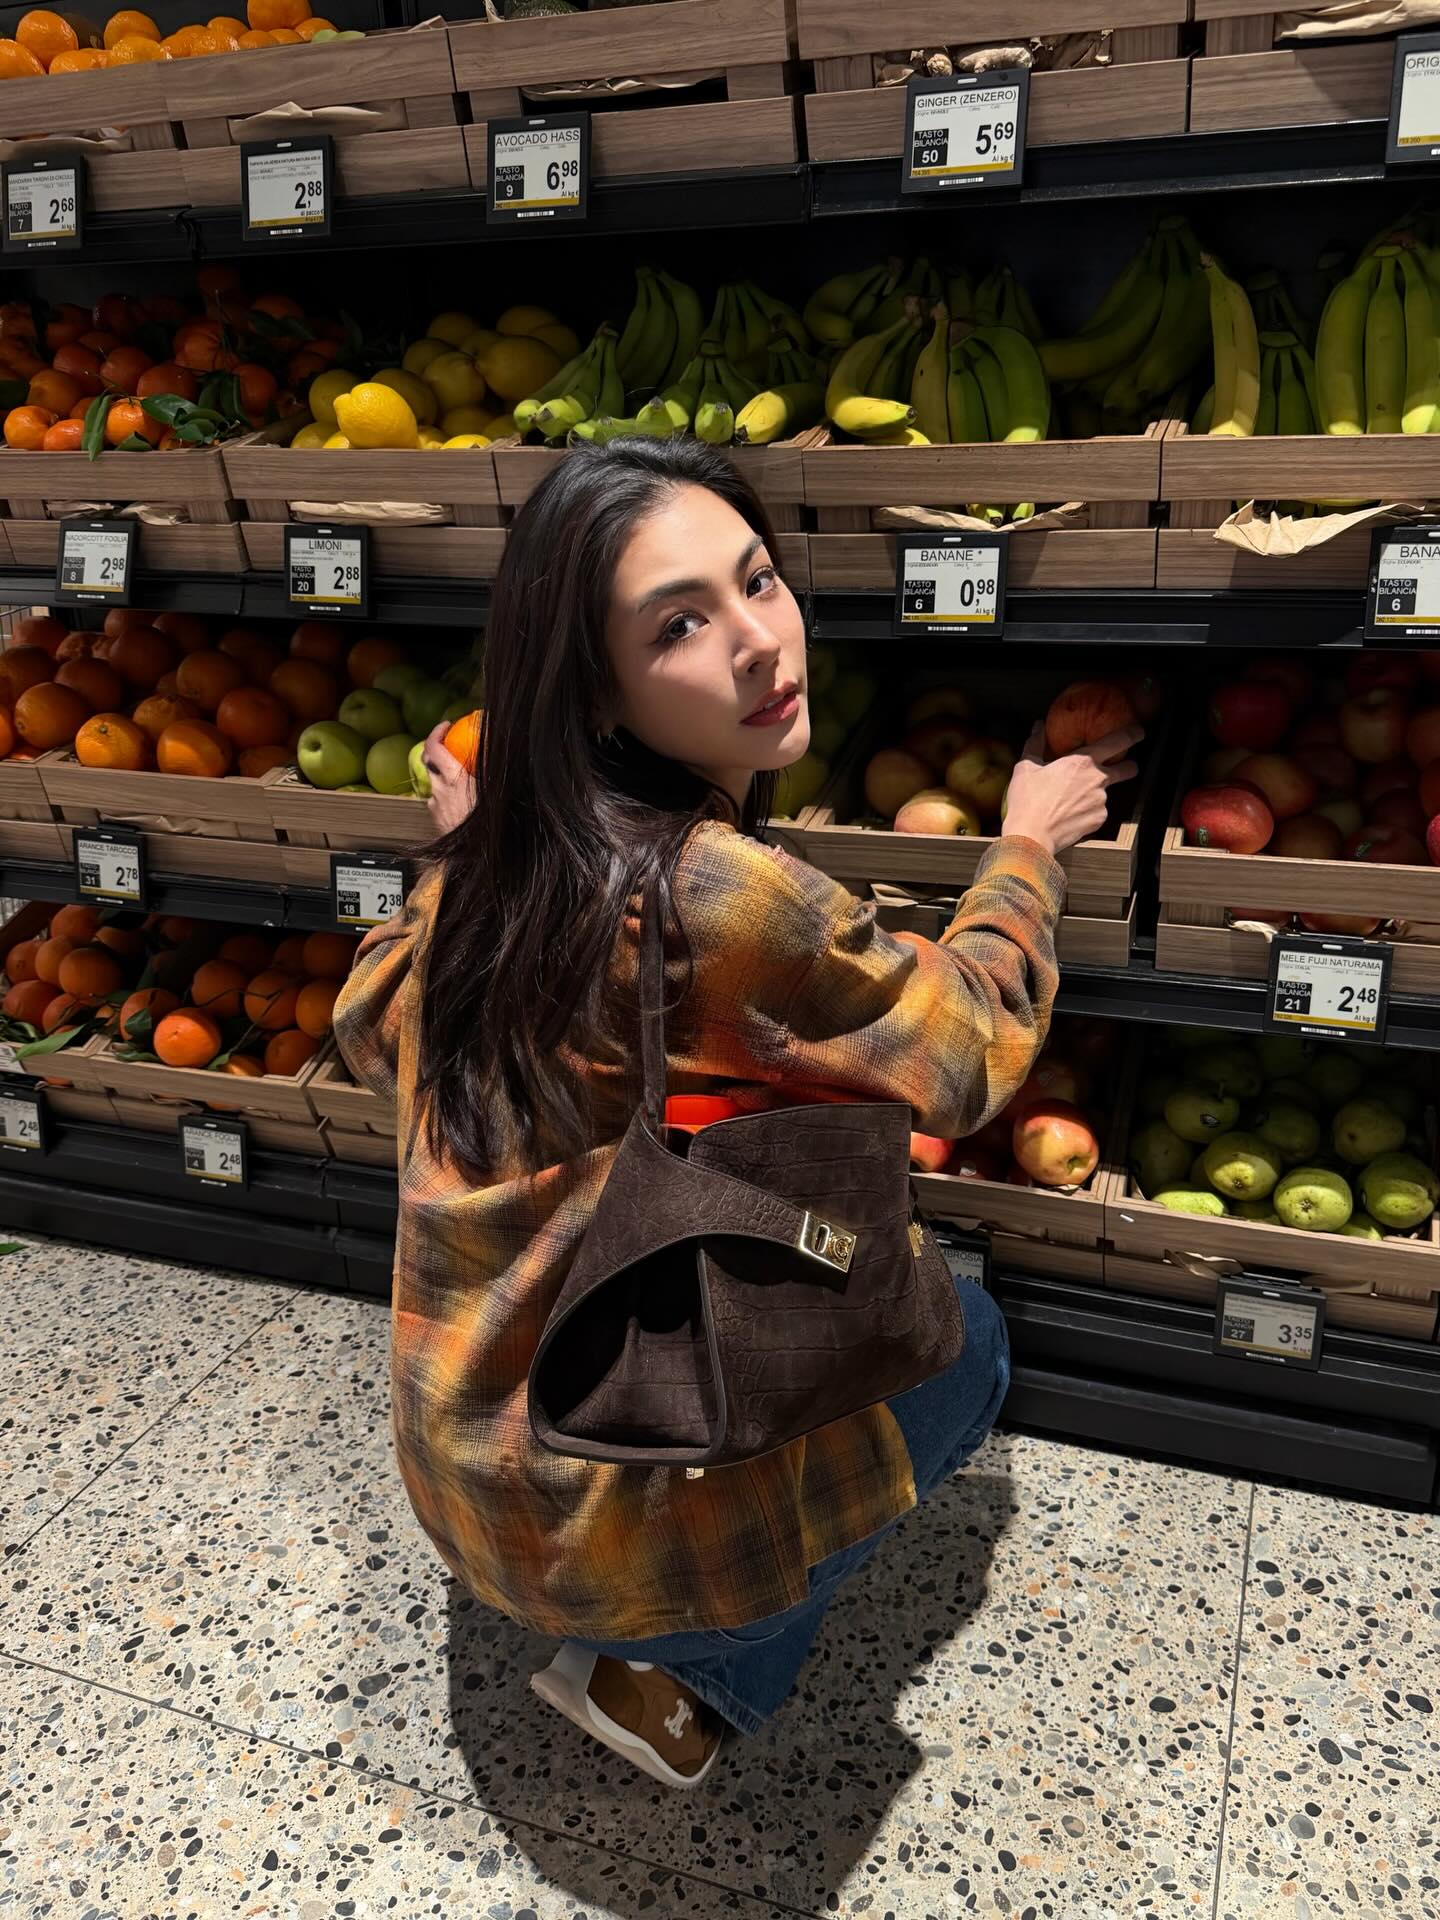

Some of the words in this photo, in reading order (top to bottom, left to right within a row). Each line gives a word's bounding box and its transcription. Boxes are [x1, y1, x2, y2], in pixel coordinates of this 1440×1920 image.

[917, 96, 957, 108] GINGER
[959, 90, 1017, 106] (ZENZERO)
[496, 132, 548, 147] AVOCADO
[551, 129, 579, 142] HASS
[918, 130, 944, 139] TASTO
[975, 121, 1014, 155] 5,69
[914, 138, 948, 148] BILANCIA
[921, 150, 939, 163] 50
[1001, 155, 1009, 163] kg
[499, 166, 520, 174] TASTO
[546, 160, 578, 190] 6,98
[496, 174, 524, 182] BILANCIA
[294, 180, 322, 209] 2,88
[506, 184, 514, 197] 9
[49, 197, 74, 225] 2,68
[18, 218, 24, 230] 7
[308, 540, 342, 550] LIMONI
[920, 549, 974, 561] BANANE
[1400, 546, 1440, 558] BANA
[100, 557, 124, 579] 2,98
[70, 571, 76, 581] 8
[333, 566, 360, 590] 2,88
[297, 581, 309, 591] 20
[1379, 587, 1417, 595] BILANCIA
[960, 578, 995, 607] 0,98
[915, 598, 923, 610] 6
[1391, 598, 1401, 611] 6
[80, 842, 105, 852] ARANCE
[106, 845, 137, 855] TAROCCO
[85, 876, 96, 885] 31
[116, 866, 138, 887] 2,78
[344, 904, 355, 914] 18
[377, 893, 402, 914] 2,38
[1280, 953, 1305, 964] MELE
[1307, 955, 1328, 966] FUJI
[1329, 958, 1381, 970] NATURAMA
[1281, 981, 1307, 990] TASTO
[1277, 987, 1311, 997] BILANCIA
[1284, 998, 1301, 1010] 21
[1337, 986, 1377, 1013] 2,48
[219, 1151, 240, 1170] 2,48
[1230, 1328, 1246, 1339] 27
[1278, 1324, 1313, 1345] 3,35
